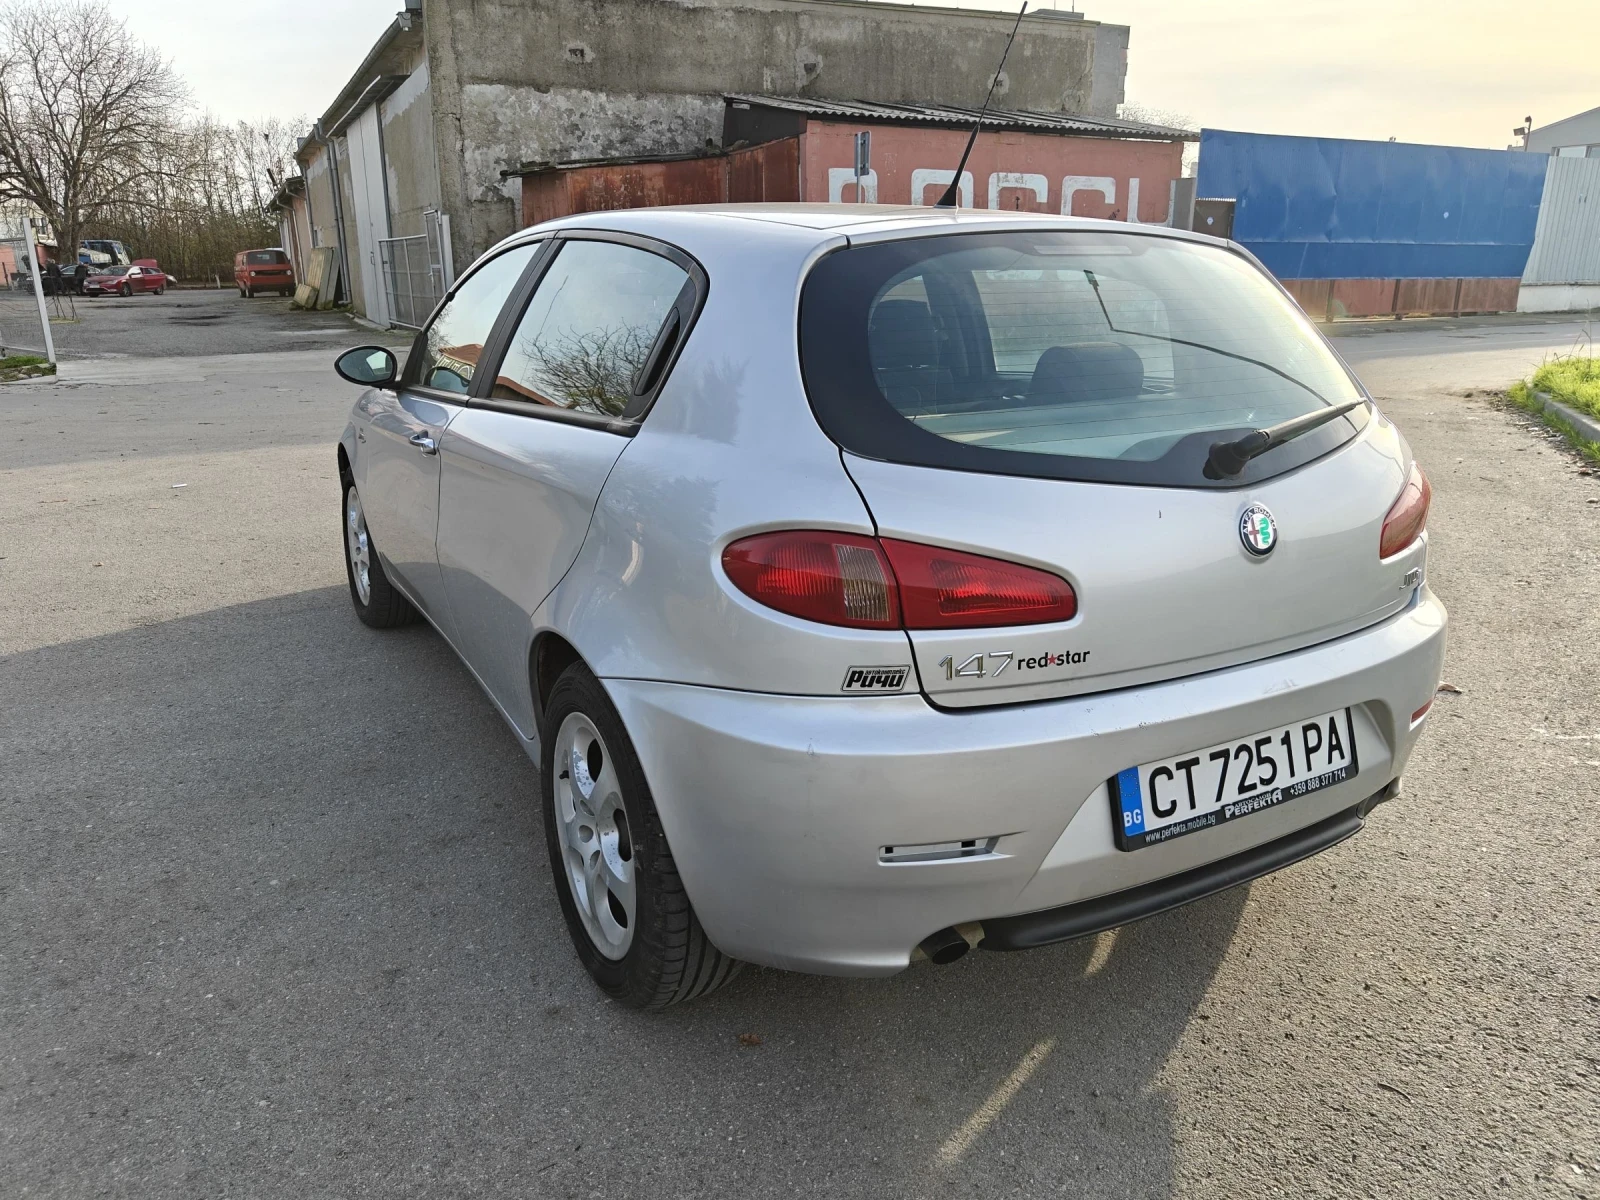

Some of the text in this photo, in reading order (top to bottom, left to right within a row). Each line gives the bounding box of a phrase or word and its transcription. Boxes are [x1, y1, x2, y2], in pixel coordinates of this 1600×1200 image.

[938, 651, 1013, 680] 147
[1290, 783, 1306, 796] +359
[1307, 777, 1320, 790] 888
[1321, 773, 1333, 786] 377
[1333, 768, 1346, 781] 714
[1123, 809, 1142, 828] BG
